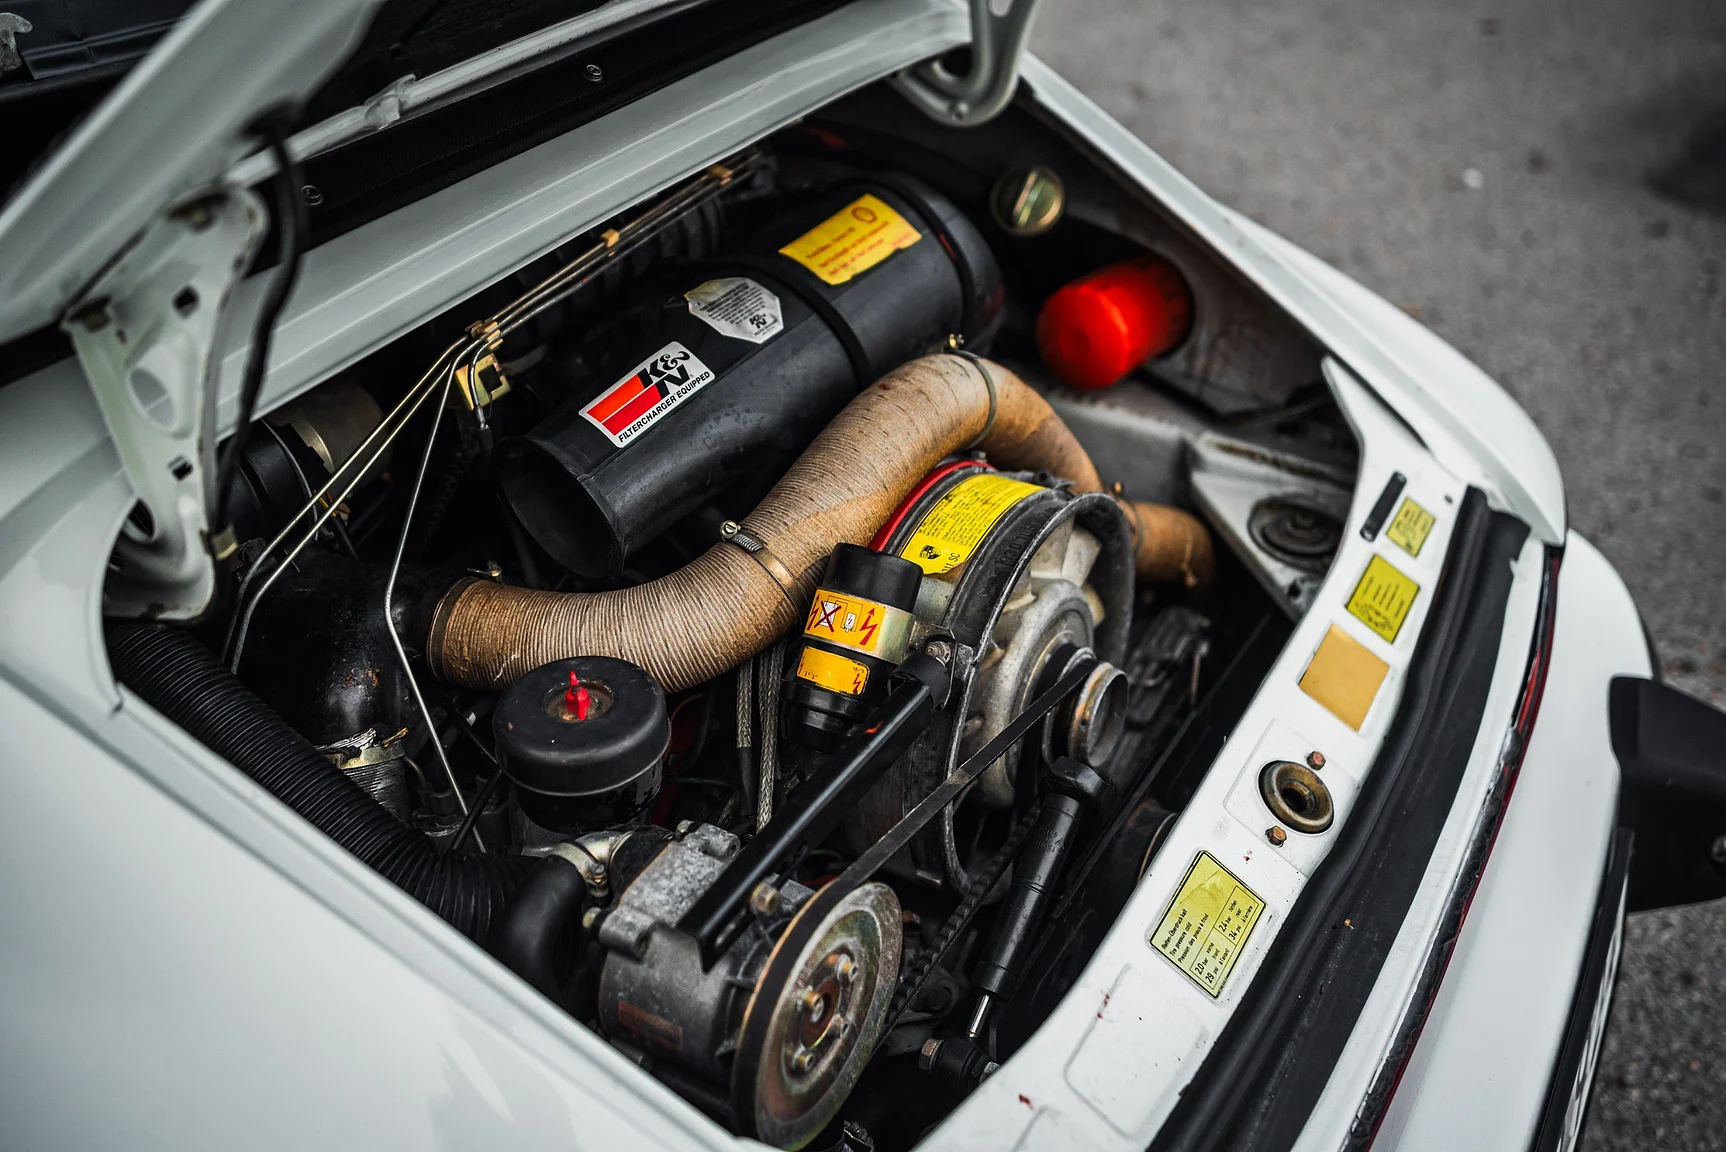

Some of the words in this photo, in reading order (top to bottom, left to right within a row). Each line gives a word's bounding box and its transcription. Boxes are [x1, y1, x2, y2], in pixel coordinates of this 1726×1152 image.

[638, 350, 690, 400] K&N
[618, 395, 677, 442] FILTERCHARGER
[676, 371, 710, 398] EQUIPPED
[948, 552, 960, 562] SC
[1175, 931, 1187, 949] pressure
[1228, 930, 1238, 940] 34
[1205, 972, 1214, 984] 29
